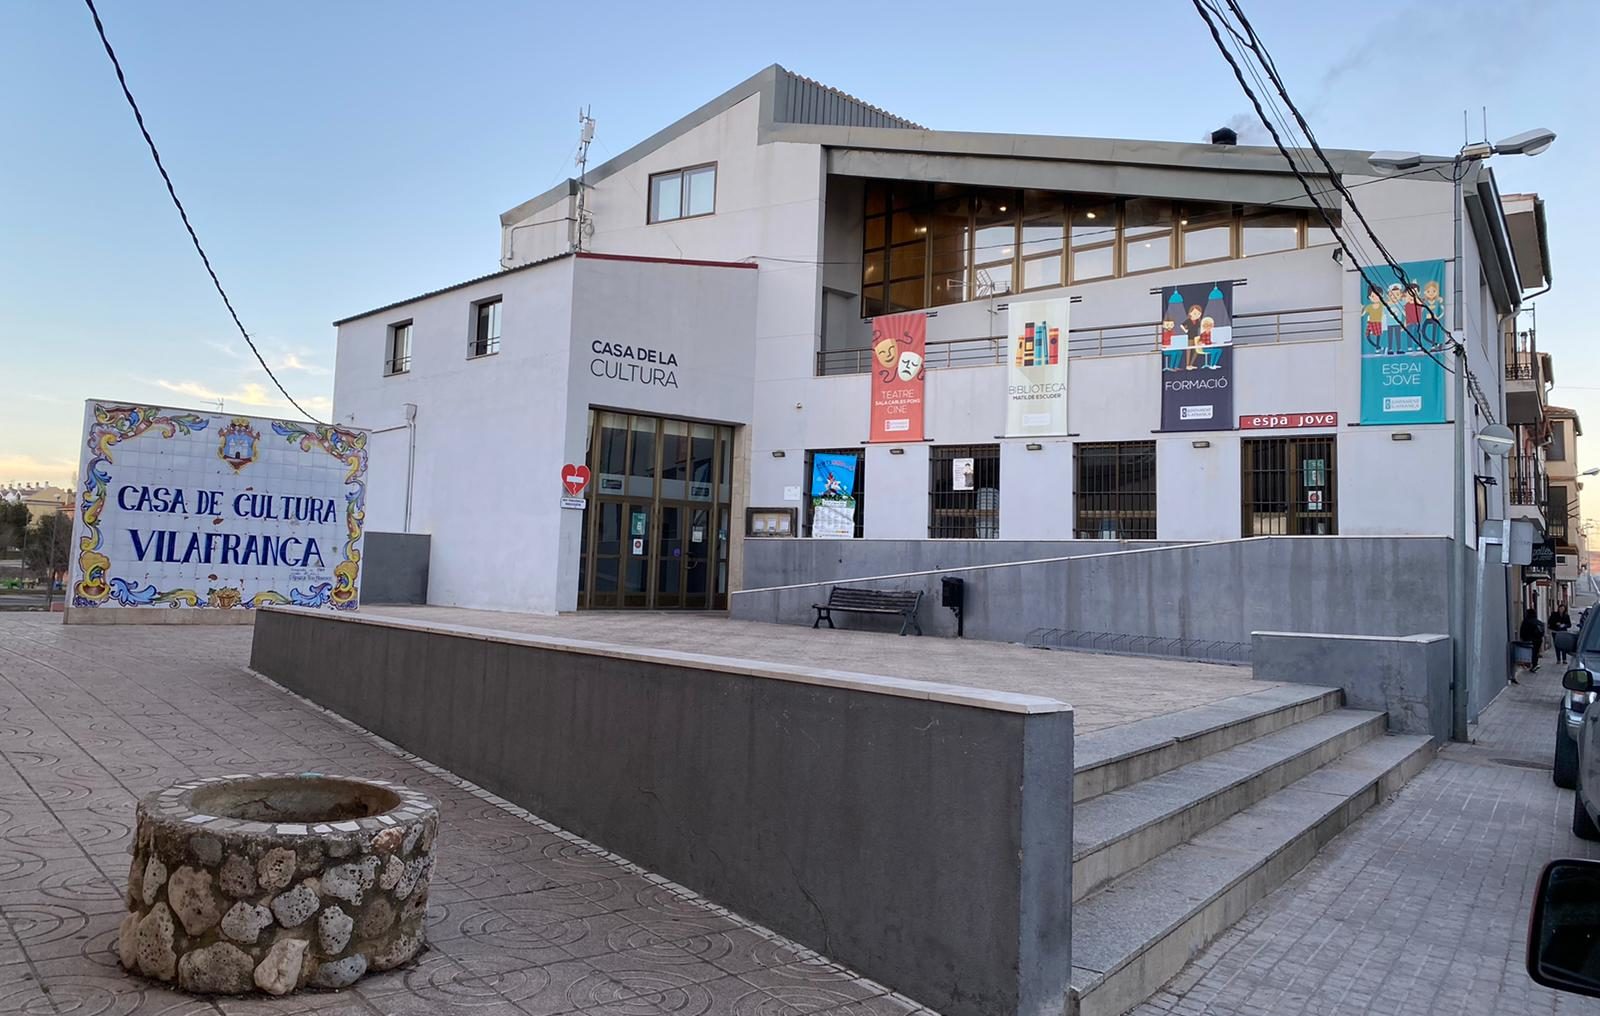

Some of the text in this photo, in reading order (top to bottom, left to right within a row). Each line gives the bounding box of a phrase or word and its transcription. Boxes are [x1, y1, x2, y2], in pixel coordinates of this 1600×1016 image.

[592, 340, 678, 367] CASA DE LA
[590, 358, 678, 389] CULTURA
[1382, 362, 1422, 374] ESPAI
[1165, 376, 1228, 391] FORMACIÓ
[1382, 374, 1422, 386] JOVE
[880, 389, 914, 399] TEATRE
[1008, 383, 1066, 395] BIBLIOTECA
[887, 405, 907, 414] CINE
[1298, 414, 1334, 427] jove
[117, 485, 337, 524] CASA DE CULTURA
[128, 528, 325, 568] VILAFRANCA
